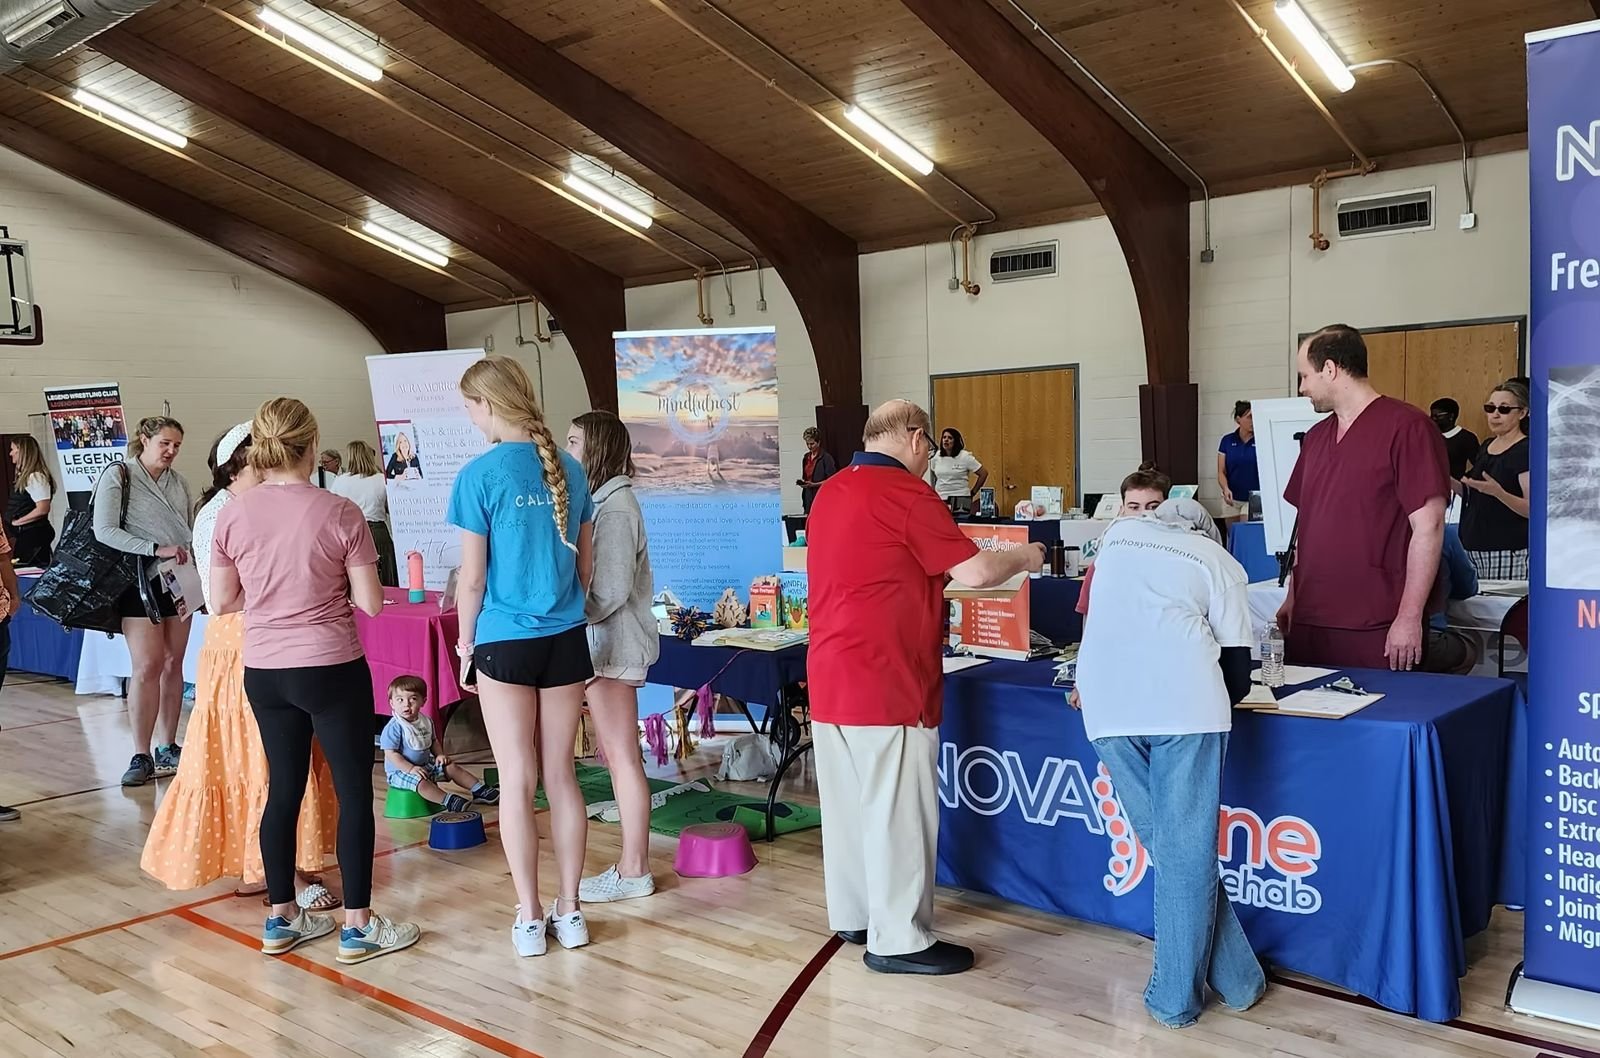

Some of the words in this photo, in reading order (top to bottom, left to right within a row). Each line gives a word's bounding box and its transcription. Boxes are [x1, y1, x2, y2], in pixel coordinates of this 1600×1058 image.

[70, 391, 102, 400] WRESTLING
[102, 390, 118, 398] CLUB
[459, 438, 467, 448] &
[64, 452, 124, 466] LEGEND
[66, 465, 105, 474] WREST
[641, 502, 667, 510] fulness
[675, 502, 712, 510] meditation
[721, 502, 738, 511] yoga
[747, 501, 780, 510] literature
[706, 516, 718, 524] and
[1559, 791, 1598, 816] Disc
[1219, 861, 1322, 914] ehab
